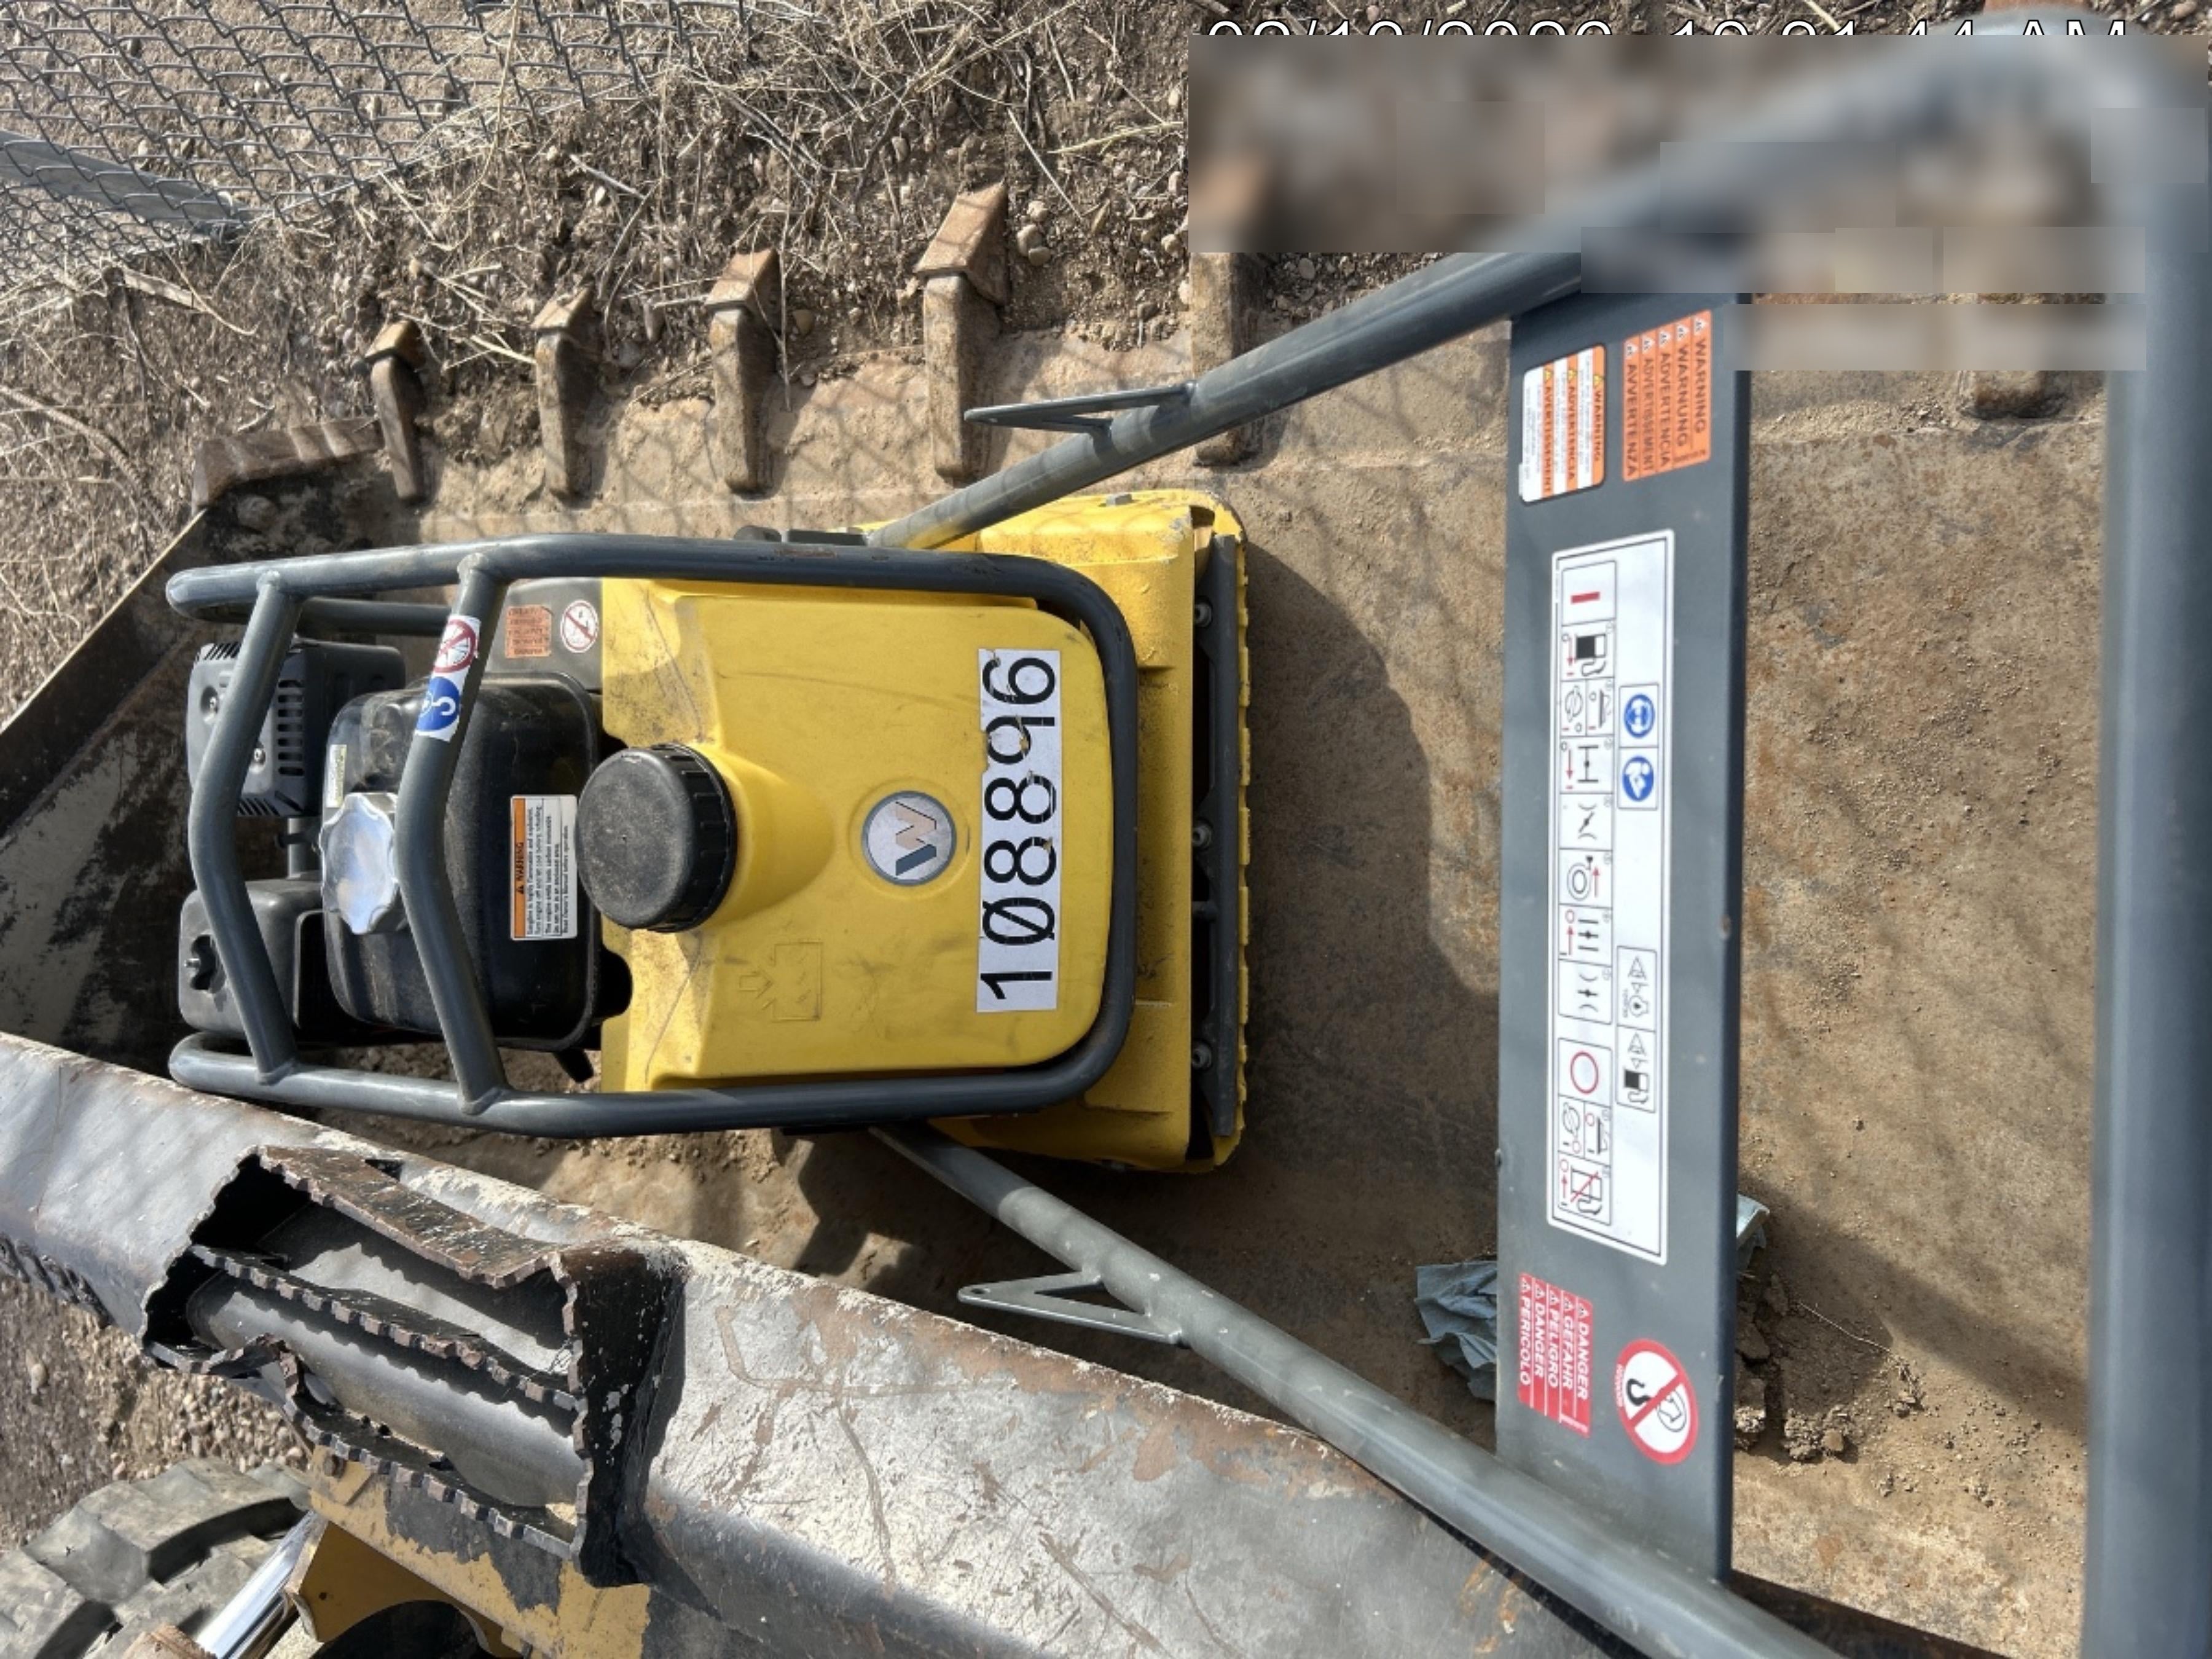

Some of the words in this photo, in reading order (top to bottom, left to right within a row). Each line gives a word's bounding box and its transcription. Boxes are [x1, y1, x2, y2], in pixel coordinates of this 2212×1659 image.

[1626, 364, 1637, 476] AVVERTENZA
[1660, 353, 1671, 466] ADVERTENCIA
[1677, 345, 1689, 447] WARNUNG
[1695, 339, 1706, 433] WARNING
[980, 657, 1057, 1000] 108896
[1520, 1296, 1530, 1386] PERICOLO
[1535, 1303, 1544, 1378] DANGER
[1549, 1309, 1558, 1387] PELIGRO
[1563, 1316, 1572, 1389] GEFAHR
[1578, 1322, 1588, 1400] DANGER
